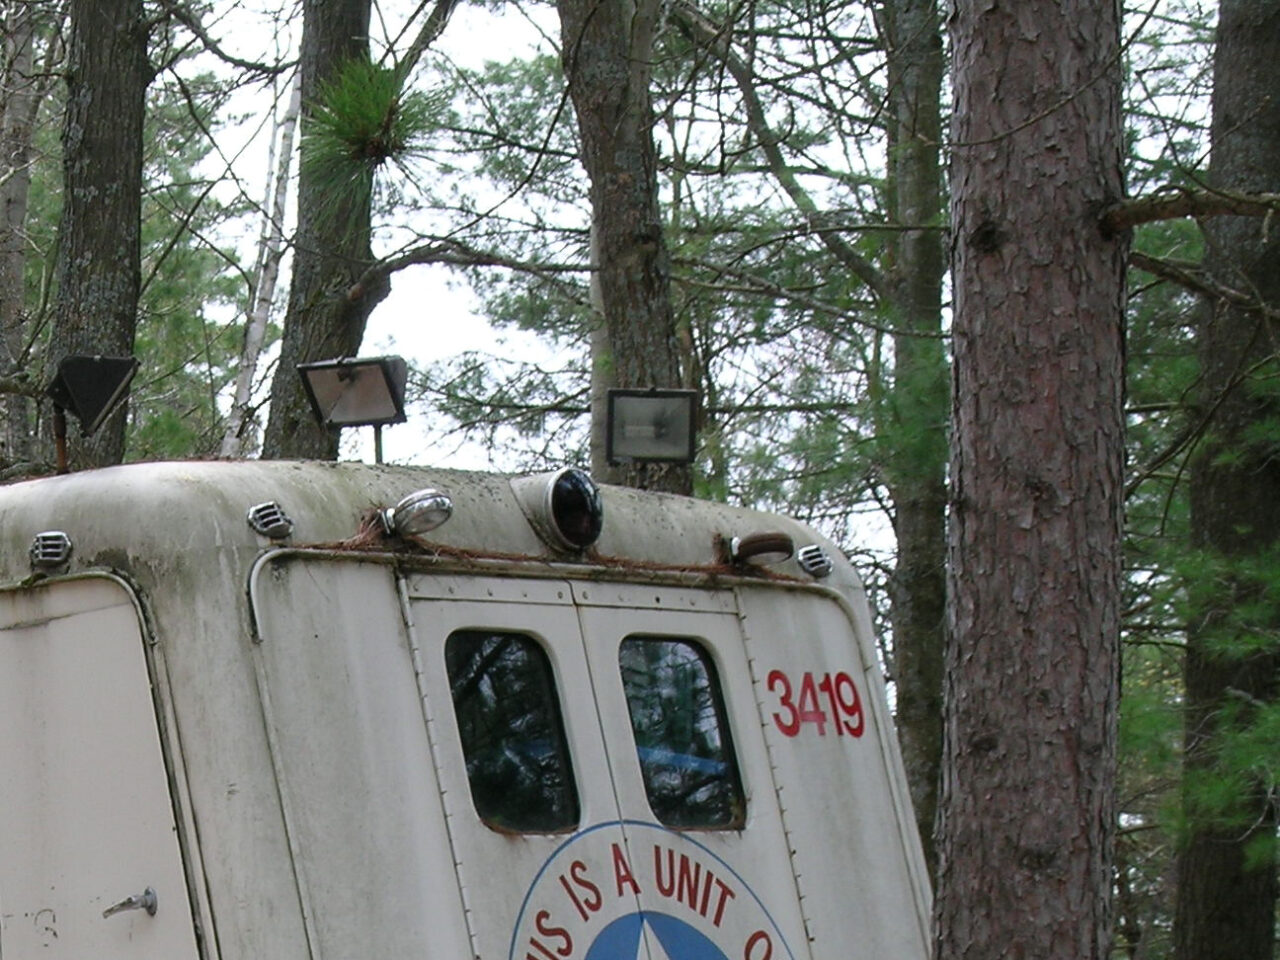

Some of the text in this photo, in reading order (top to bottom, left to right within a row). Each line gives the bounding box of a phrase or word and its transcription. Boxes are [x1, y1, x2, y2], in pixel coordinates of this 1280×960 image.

[767, 669, 865, 738] 3419
[559, 860, 603, 922] IS
[612, 843, 640, 897] A
[654, 845, 736, 927] UNIT
